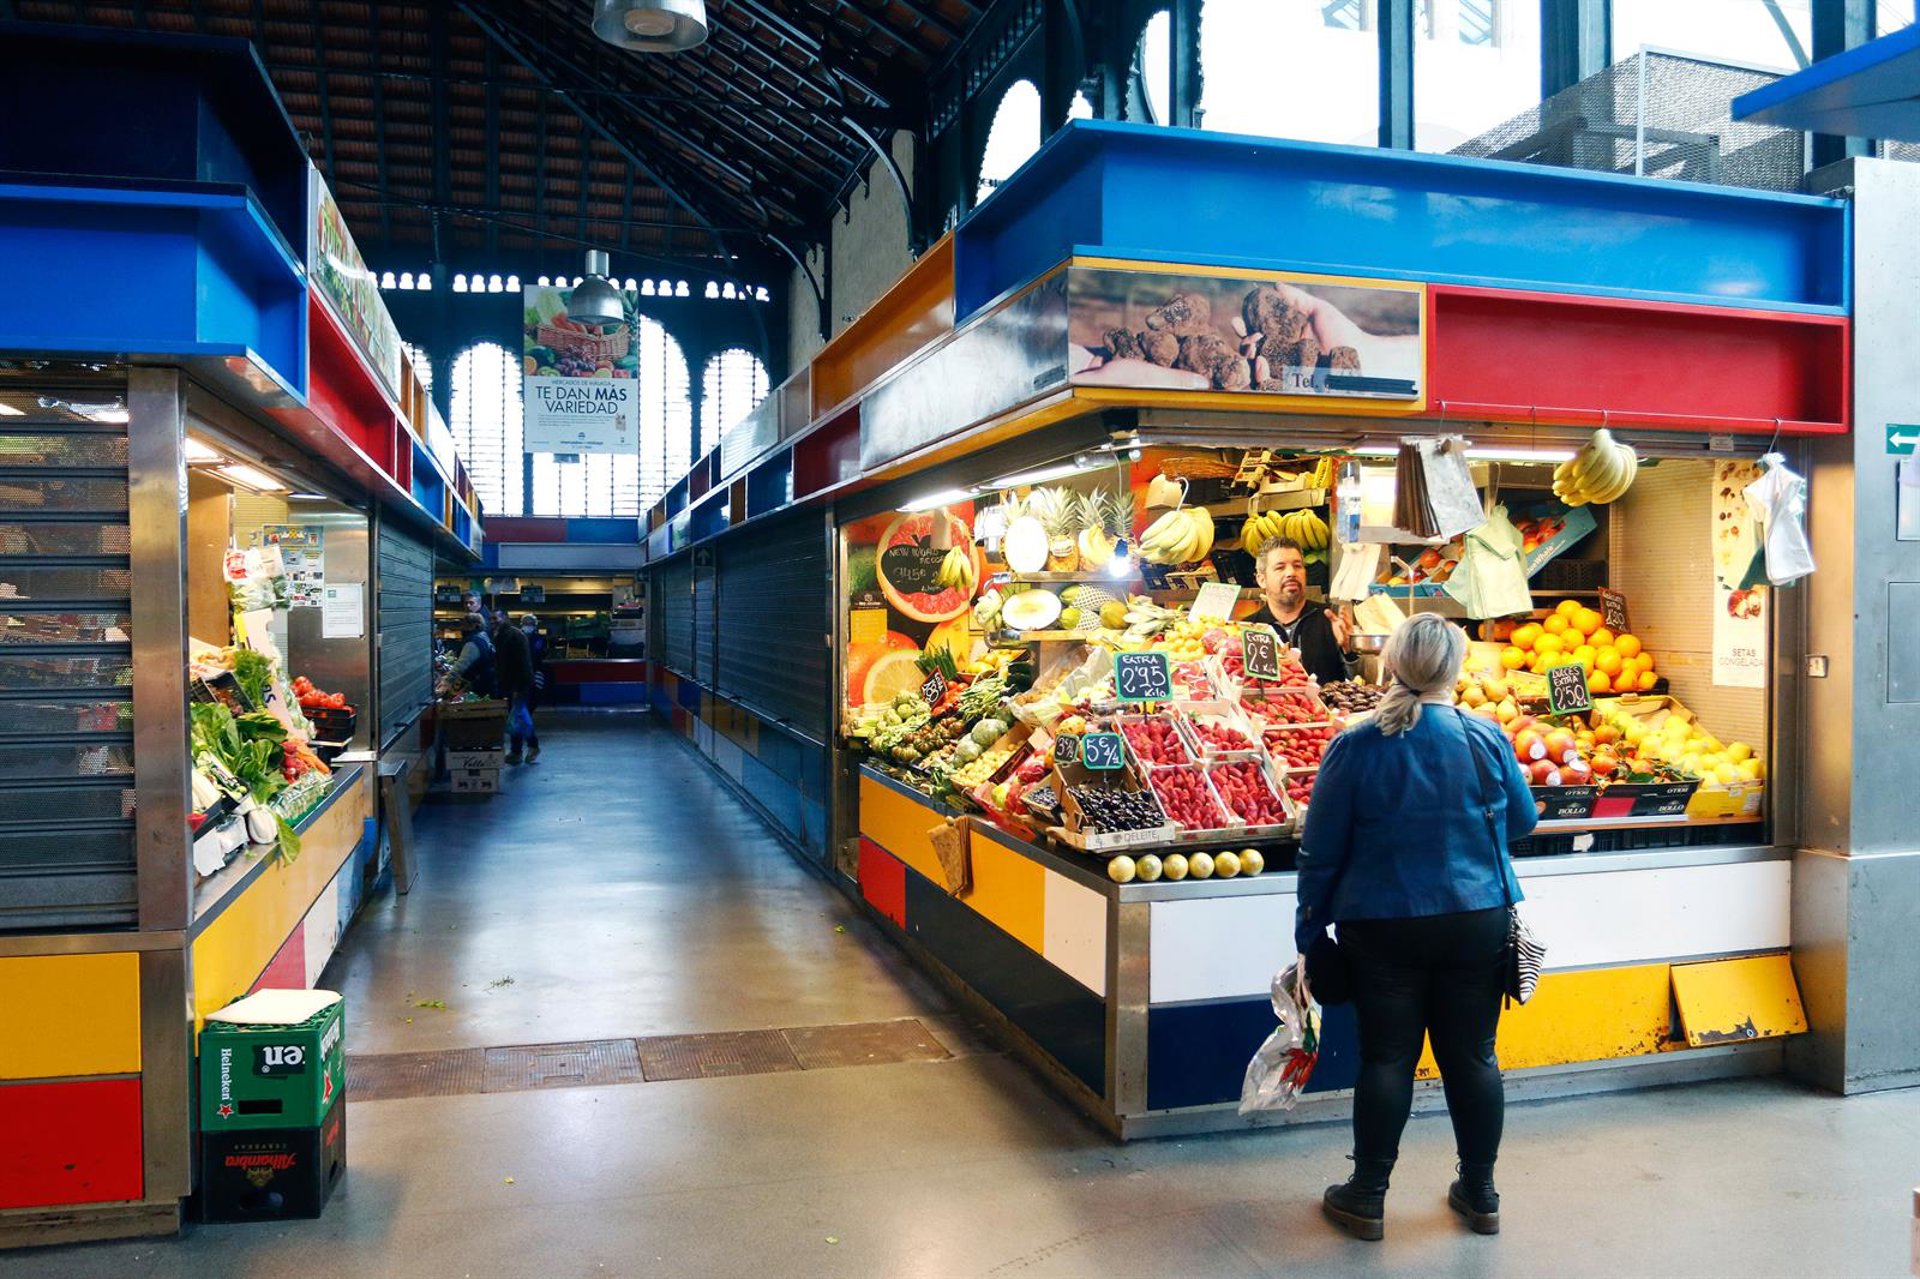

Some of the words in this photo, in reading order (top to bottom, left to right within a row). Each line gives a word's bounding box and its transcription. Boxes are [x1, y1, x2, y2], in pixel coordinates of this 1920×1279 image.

[1291, 372, 1319, 389] Tel.
[536, 386, 552, 399] TE
[556, 387, 590, 400] DAN
[594, 384, 627, 401] MÁS
[545, 400, 619, 415] VARIEDAD
[1122, 655, 1158, 664] EXTRA
[1732, 648, 1756, 657] SETAS
[1122, 665, 1166, 693] 2'95
[1555, 684, 1585, 710] 2'50
[1558, 807, 1587, 815] BOLLO
[1658, 804, 1685, 812] BOLLO
[220, 1047, 233, 1101] Heineken
[225, 1152, 298, 1171] Alhambra
